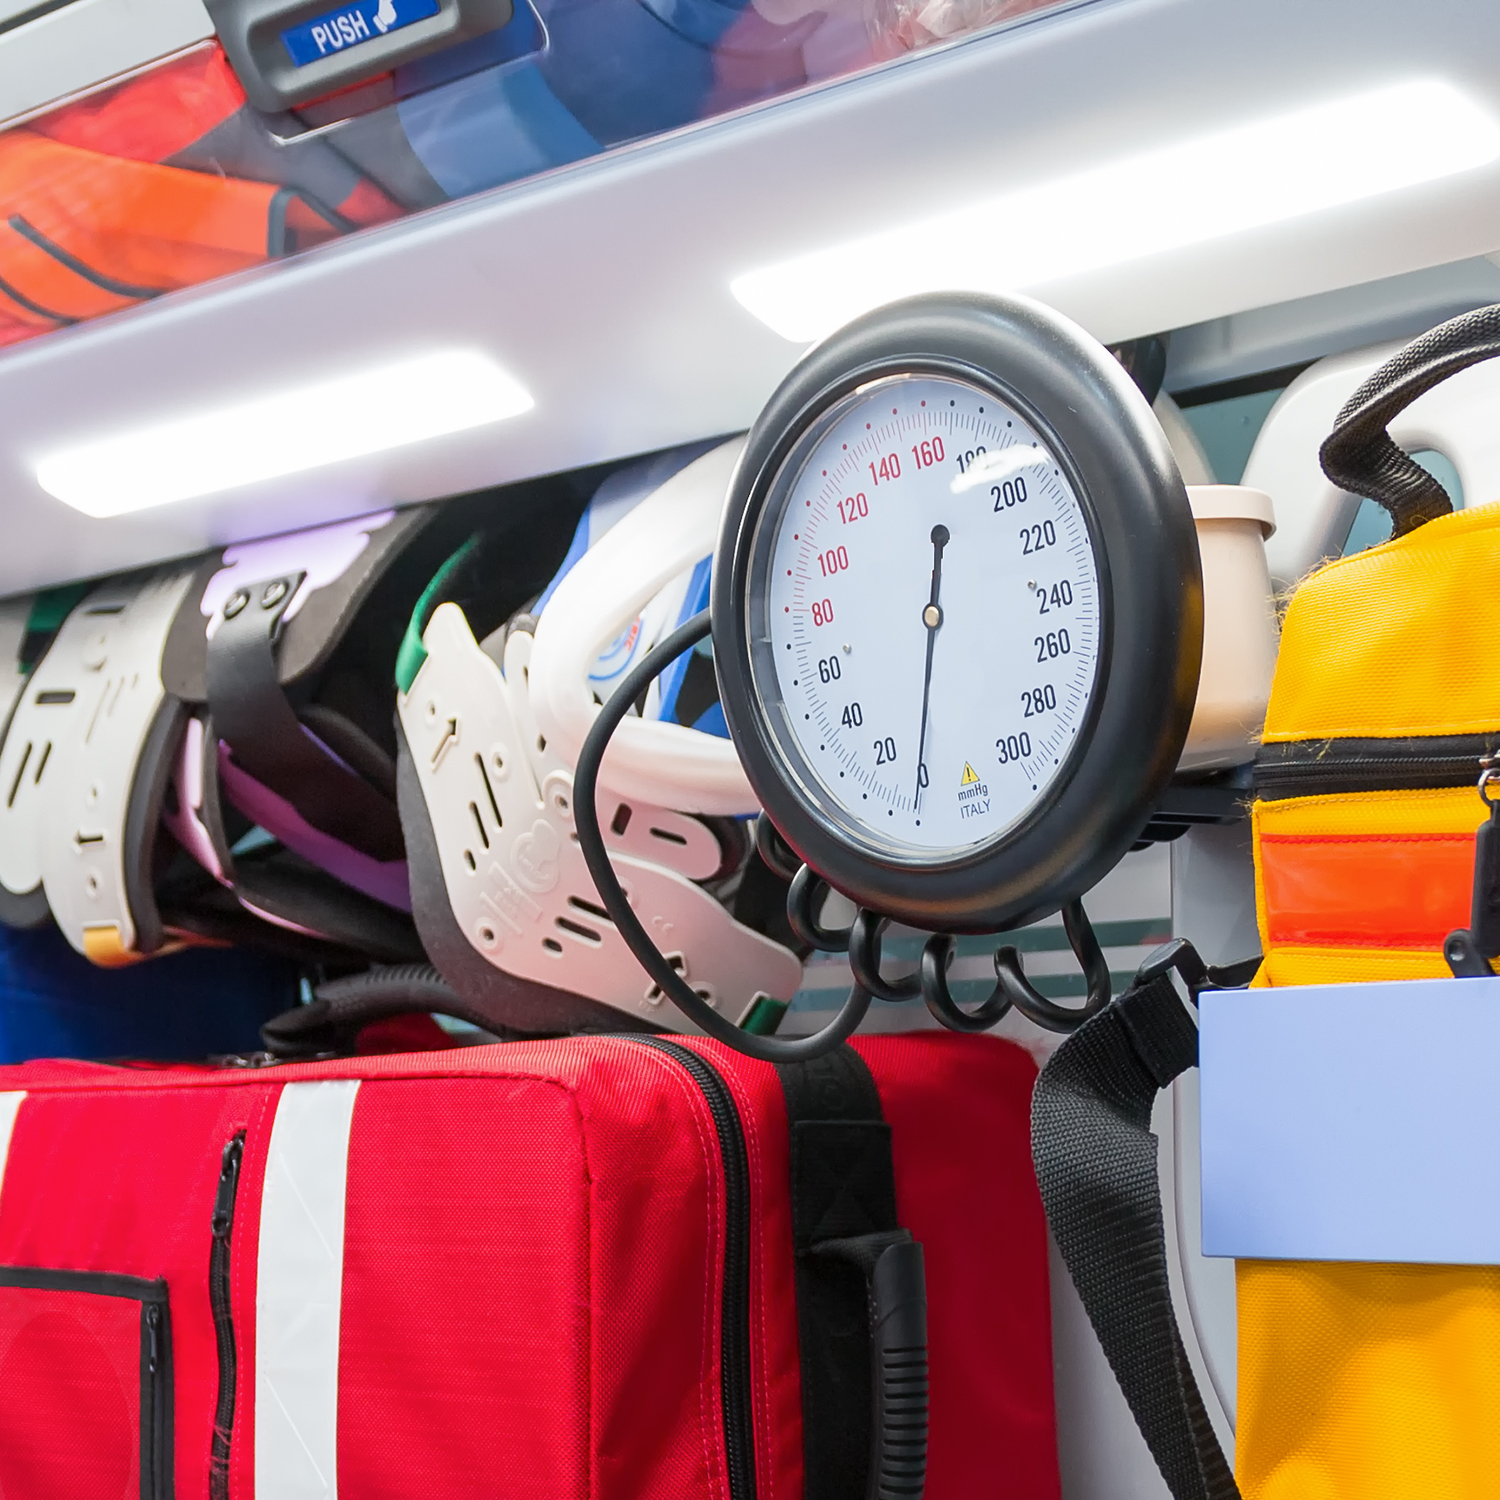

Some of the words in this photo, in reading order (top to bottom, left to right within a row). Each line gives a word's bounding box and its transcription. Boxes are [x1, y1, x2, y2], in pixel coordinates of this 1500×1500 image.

[311, 10, 370, 54] PUSH
[911, 436, 945, 470] 160
[868, 453, 901, 486] 140
[837, 493, 869, 524] 120
[990, 476, 1027, 512] 200
[1020, 520, 1056, 555] 220
[817, 545, 849, 577] 100
[812, 598, 834, 626] 80
[1036, 580, 1073, 614] 240
[1034, 628, 1071, 663] 260
[819, 656, 841, 683] 60
[842, 702, 863, 728] 40
[1021, 684, 1056, 717] 280
[873, 737, 896, 765] 20
[996, 732, 1032, 764] 300
[917, 763, 929, 788] 0
[958, 783, 989, 801] mmHg
[960, 799, 991, 819] ITALY
